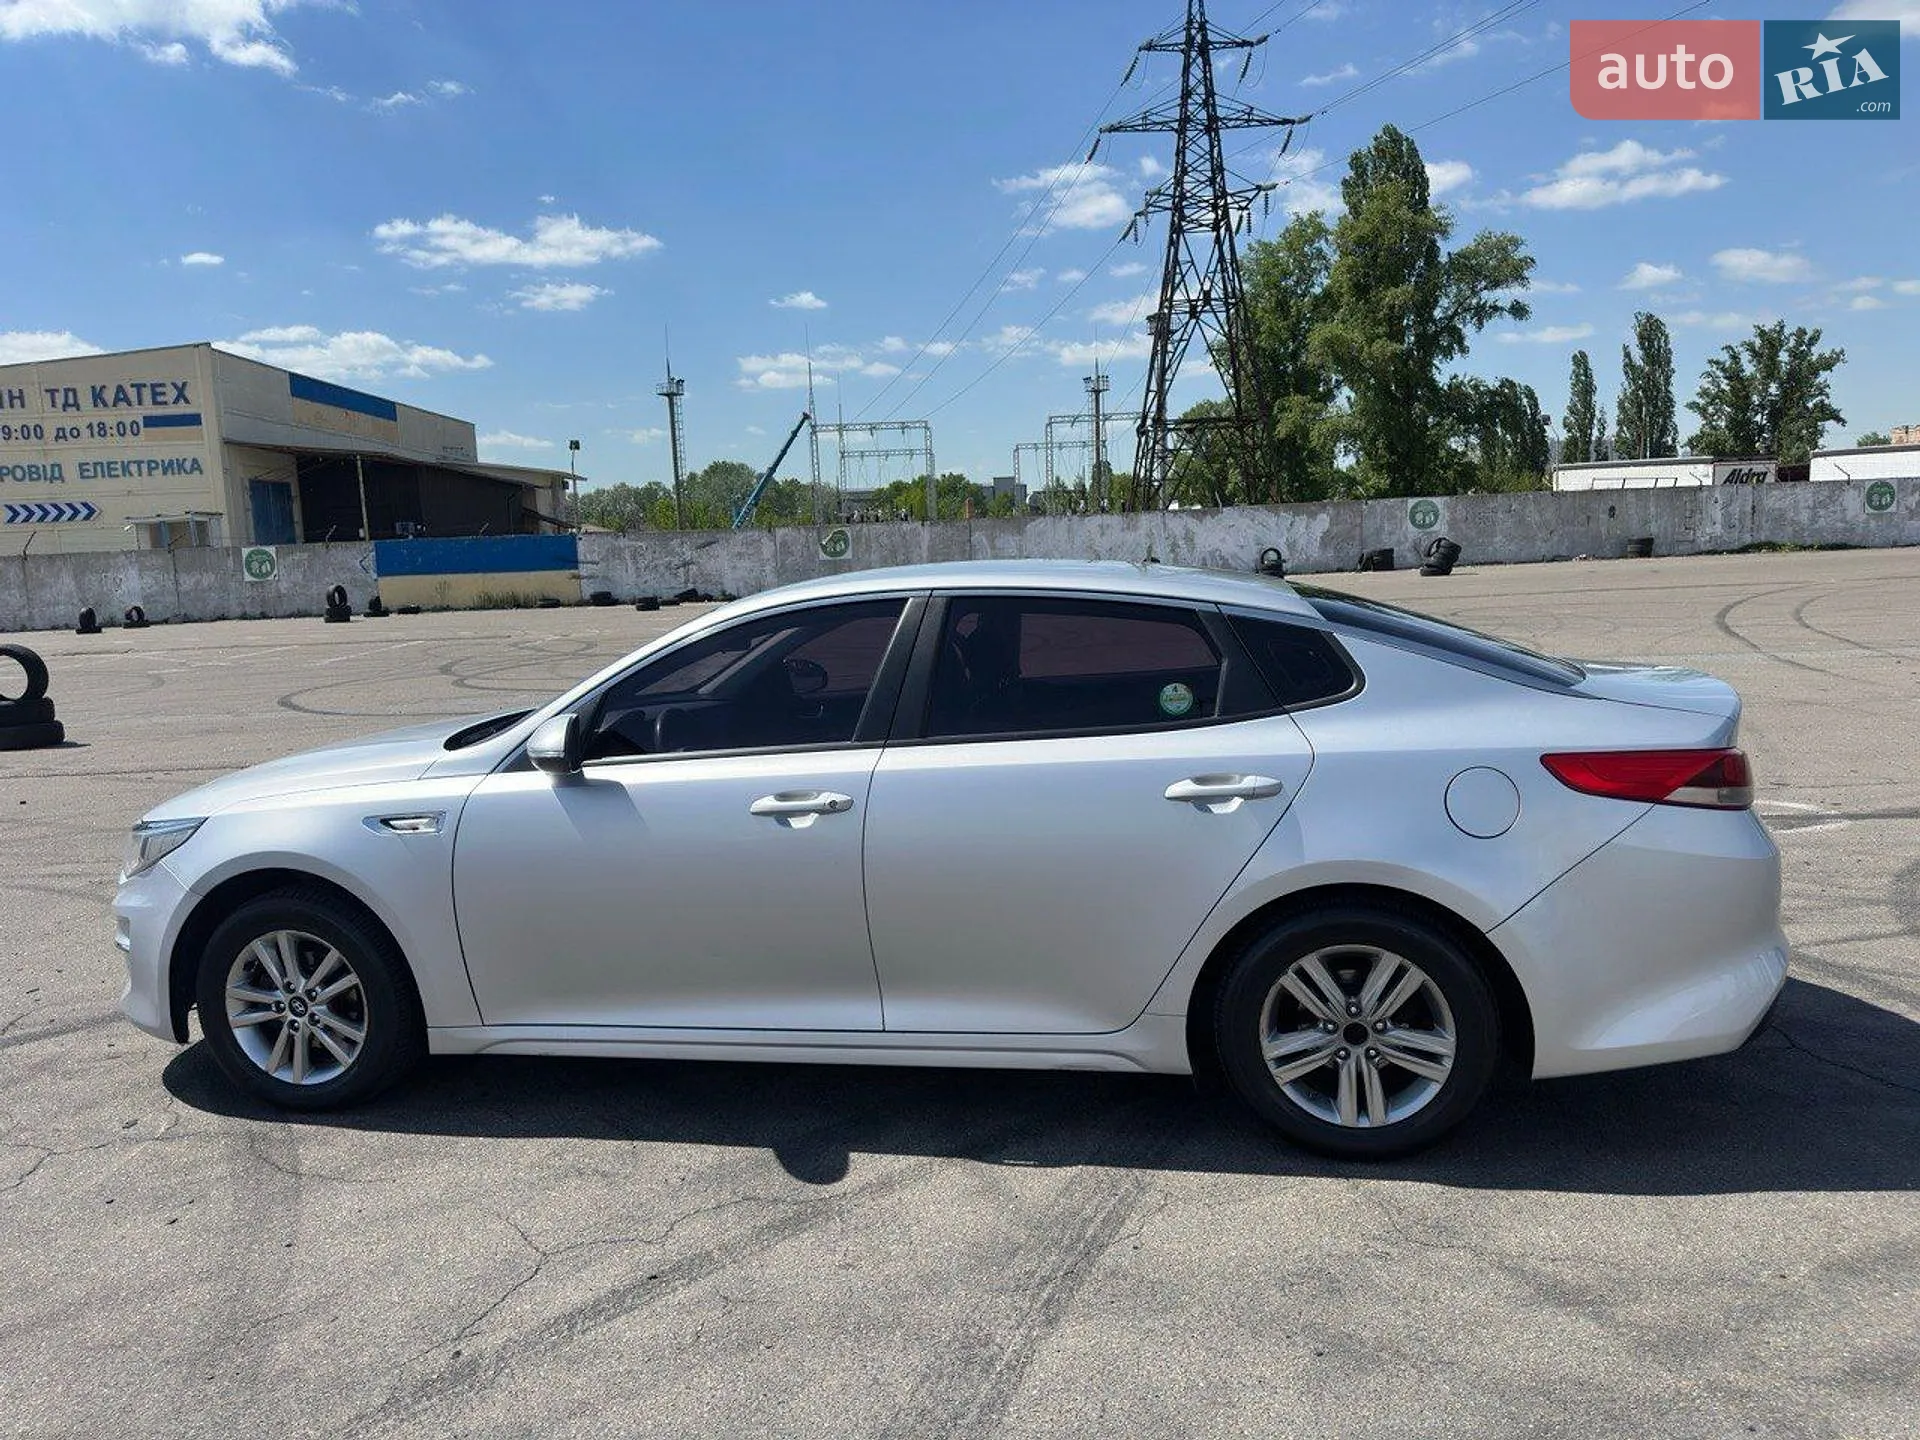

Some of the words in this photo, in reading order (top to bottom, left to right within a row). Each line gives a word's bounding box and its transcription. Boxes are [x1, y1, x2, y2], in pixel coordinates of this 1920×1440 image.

[0, 388, 25, 409] Н
[44, 387, 81, 412] ТД
[91, 381, 191, 408] КАТЕХ
[2, 424, 44, 441] 9:00
[55, 426, 80, 442] до
[86, 420, 140, 438] 18:00
[78, 457, 204, 480] ЕЛЕКТРИКА
